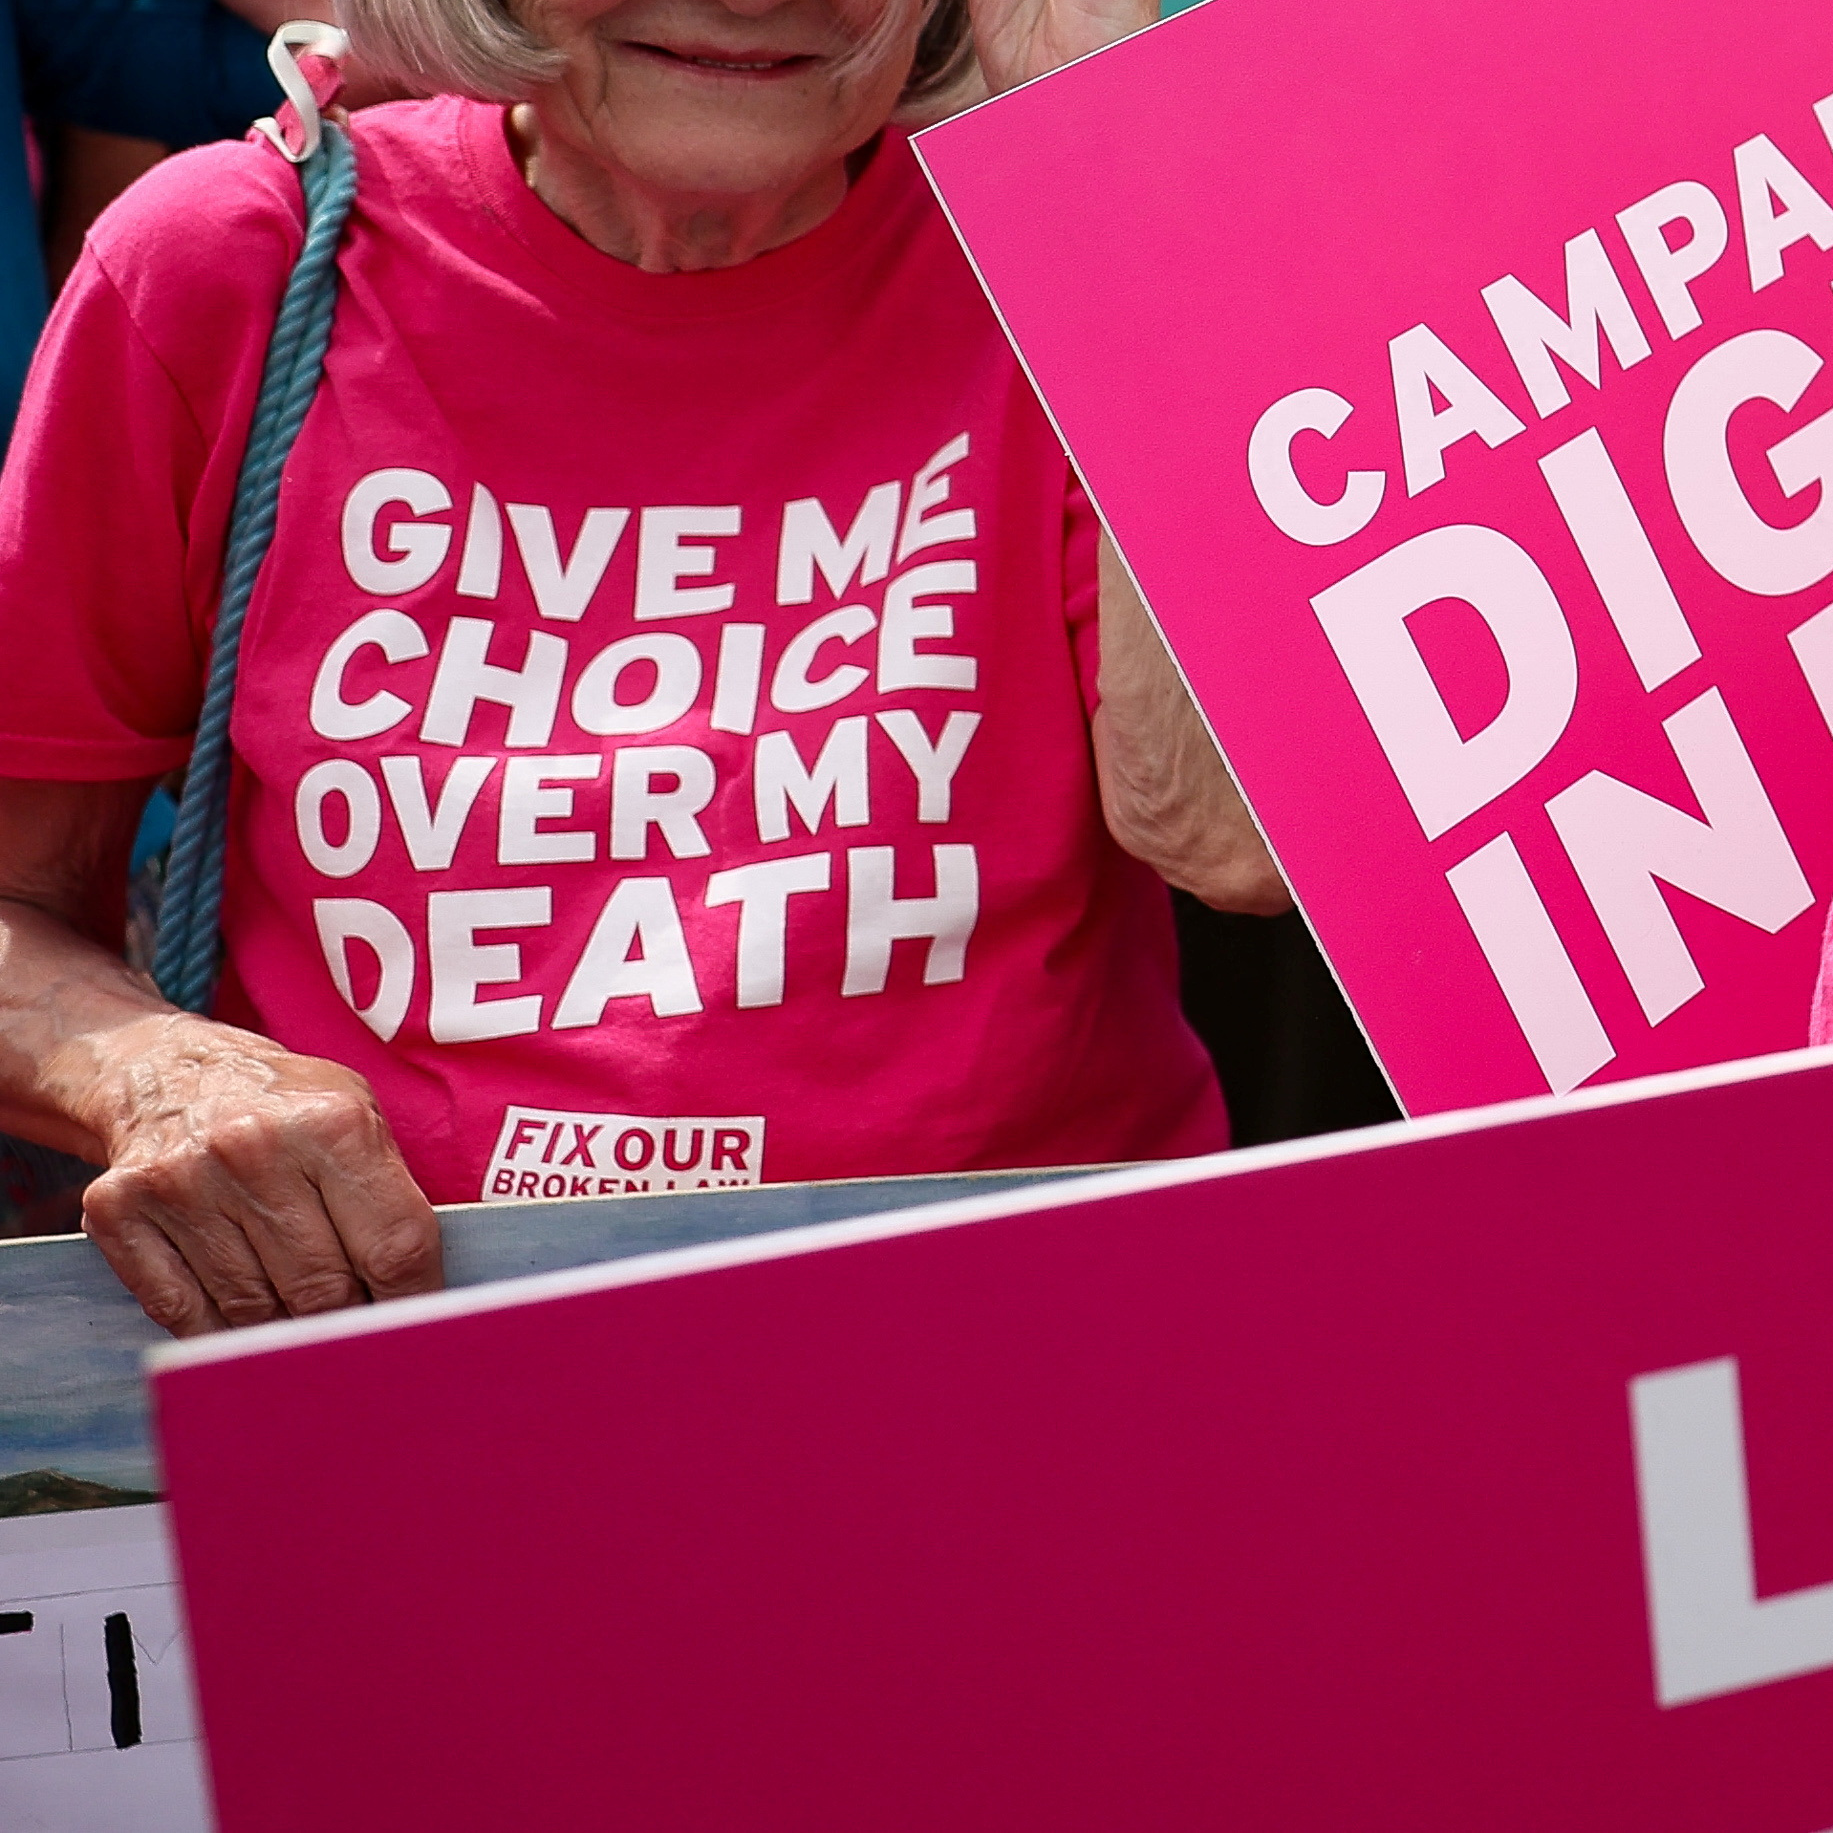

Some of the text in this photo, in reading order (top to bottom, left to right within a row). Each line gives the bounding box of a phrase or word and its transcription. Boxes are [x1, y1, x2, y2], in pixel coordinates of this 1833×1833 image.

[341, 431, 977, 623] GIVE ME
[309, 559, 978, 749] CHOICE
[295, 709, 982, 879] OVER MY
[311, 843, 980, 1046] DEATH
[1444, 684, 1816, 1100] IN
[504, 1118, 752, 1172] FIX OUR
